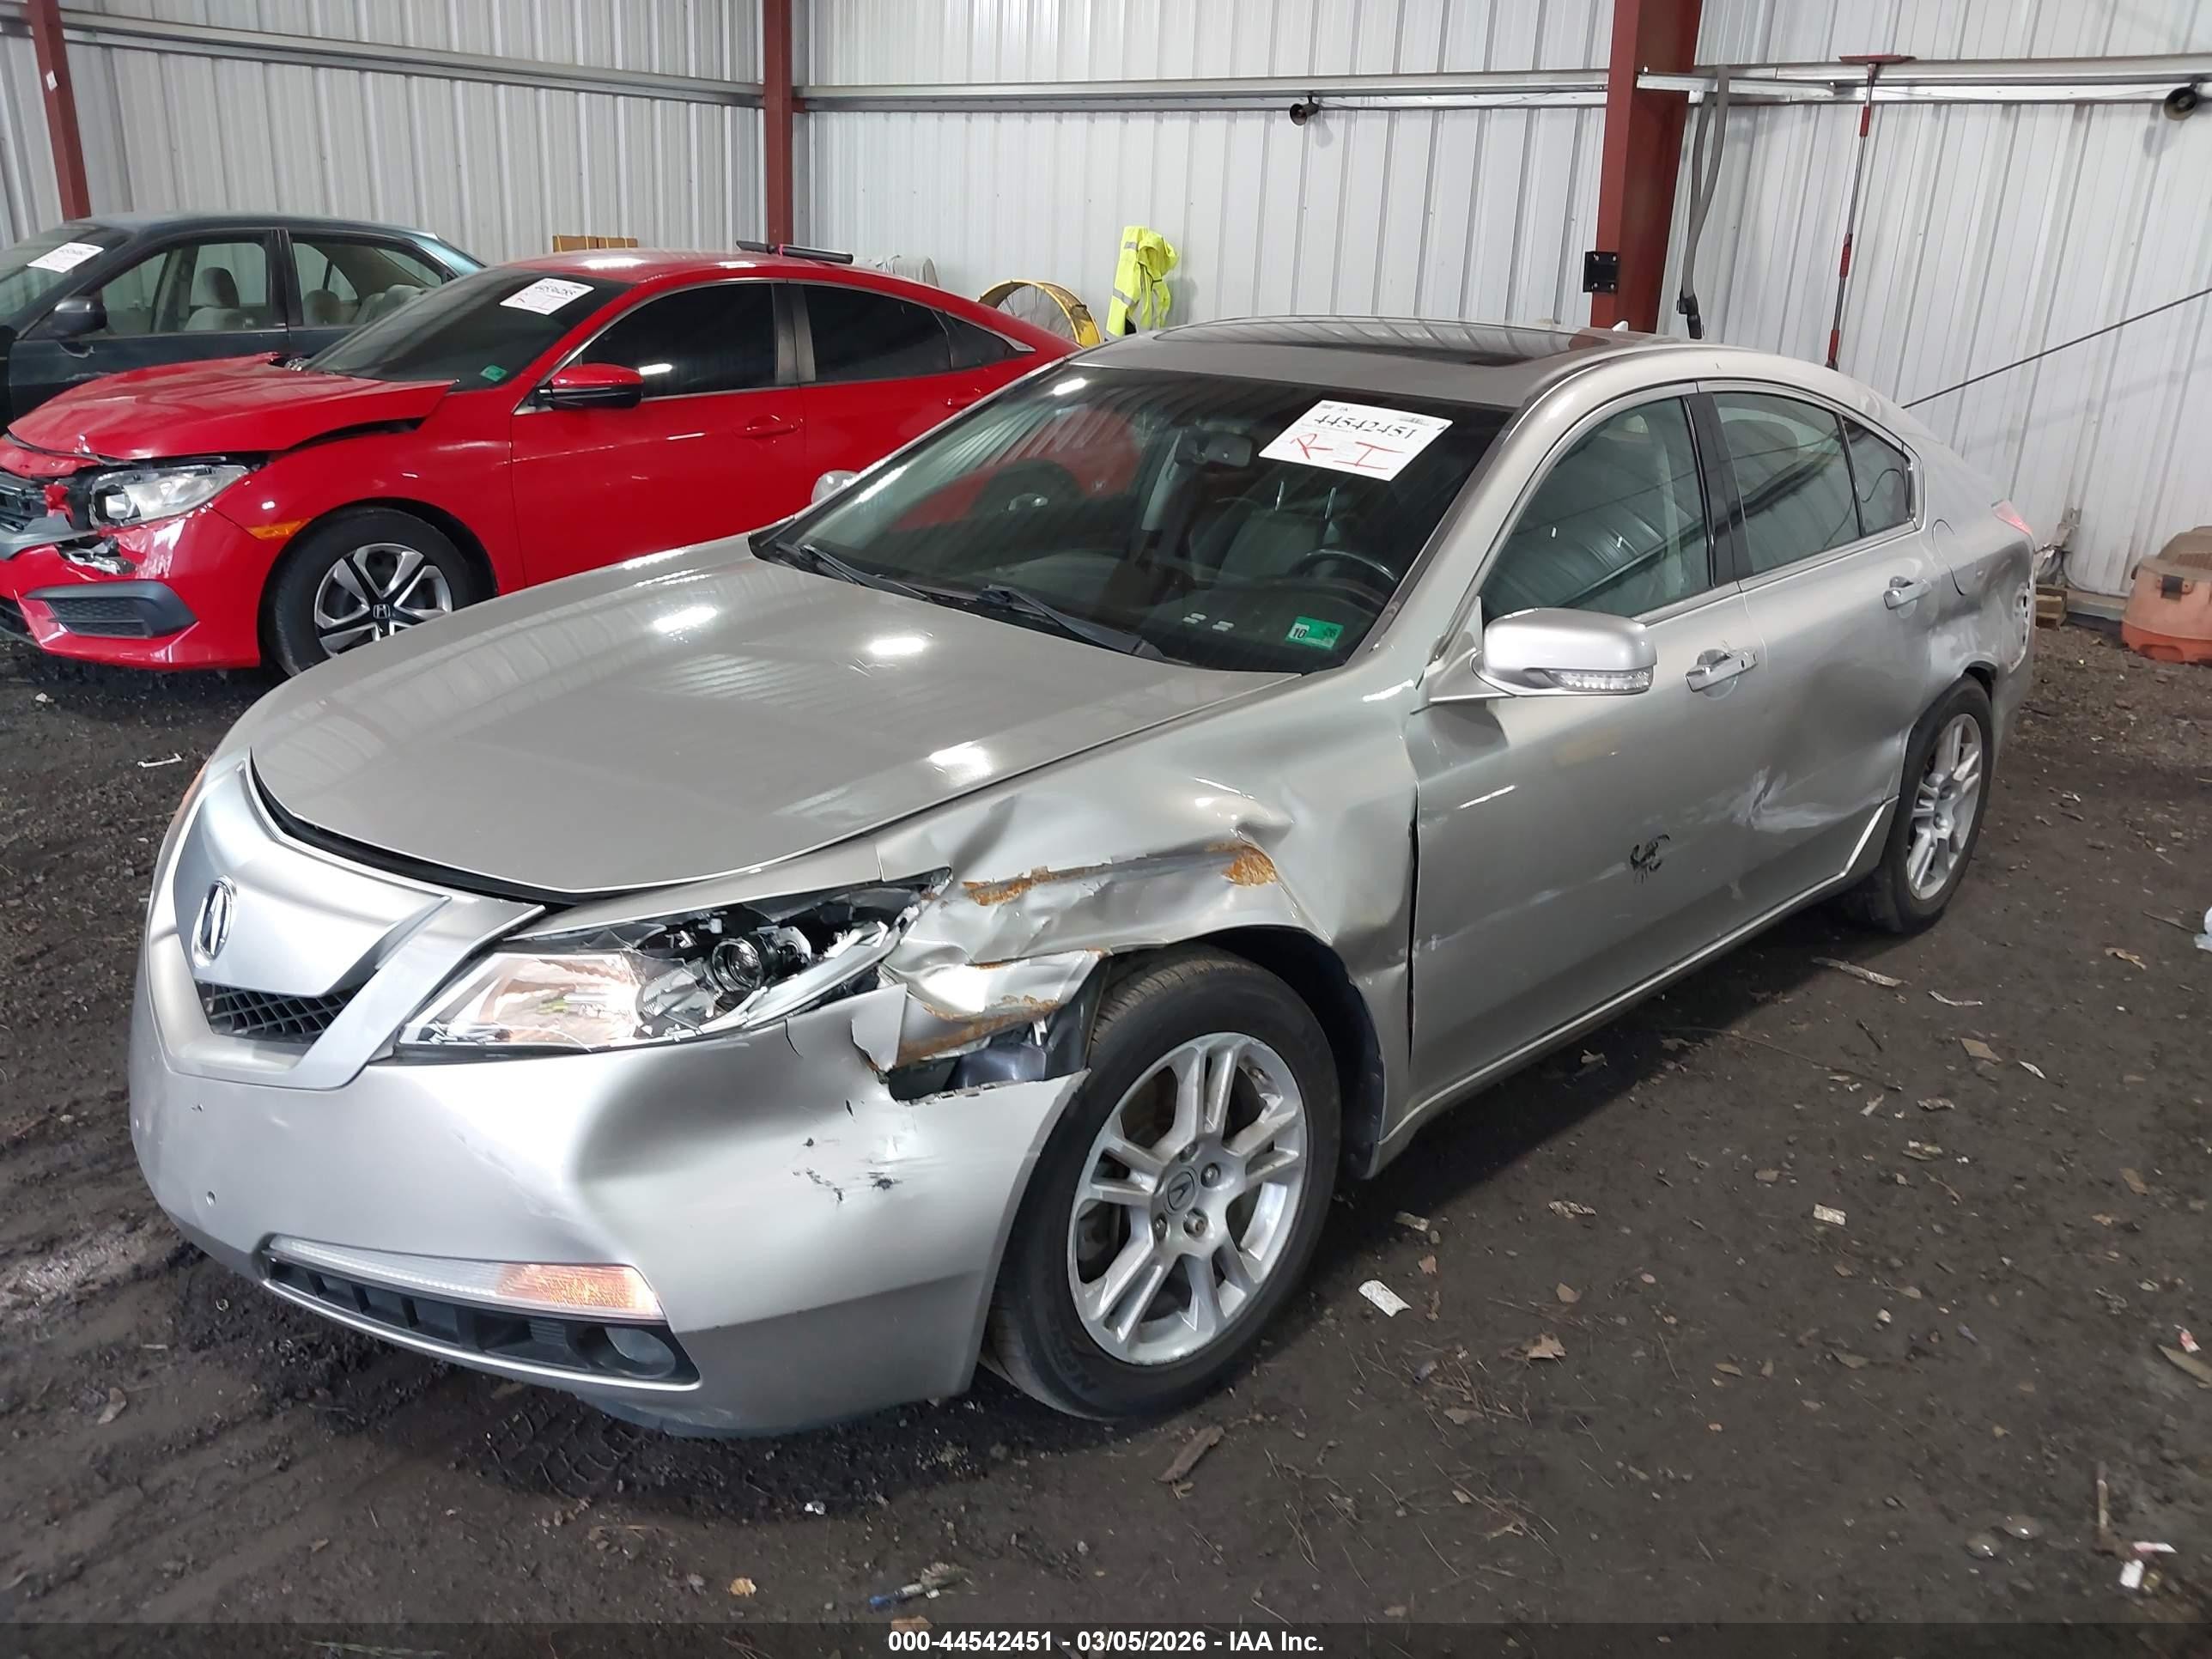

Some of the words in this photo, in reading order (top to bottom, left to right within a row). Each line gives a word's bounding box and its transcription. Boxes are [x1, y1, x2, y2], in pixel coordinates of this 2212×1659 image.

[1313, 414, 1418, 440] 44542451
[1290, 434, 1334, 460] R
[1293, 627, 1307, 639] 10
